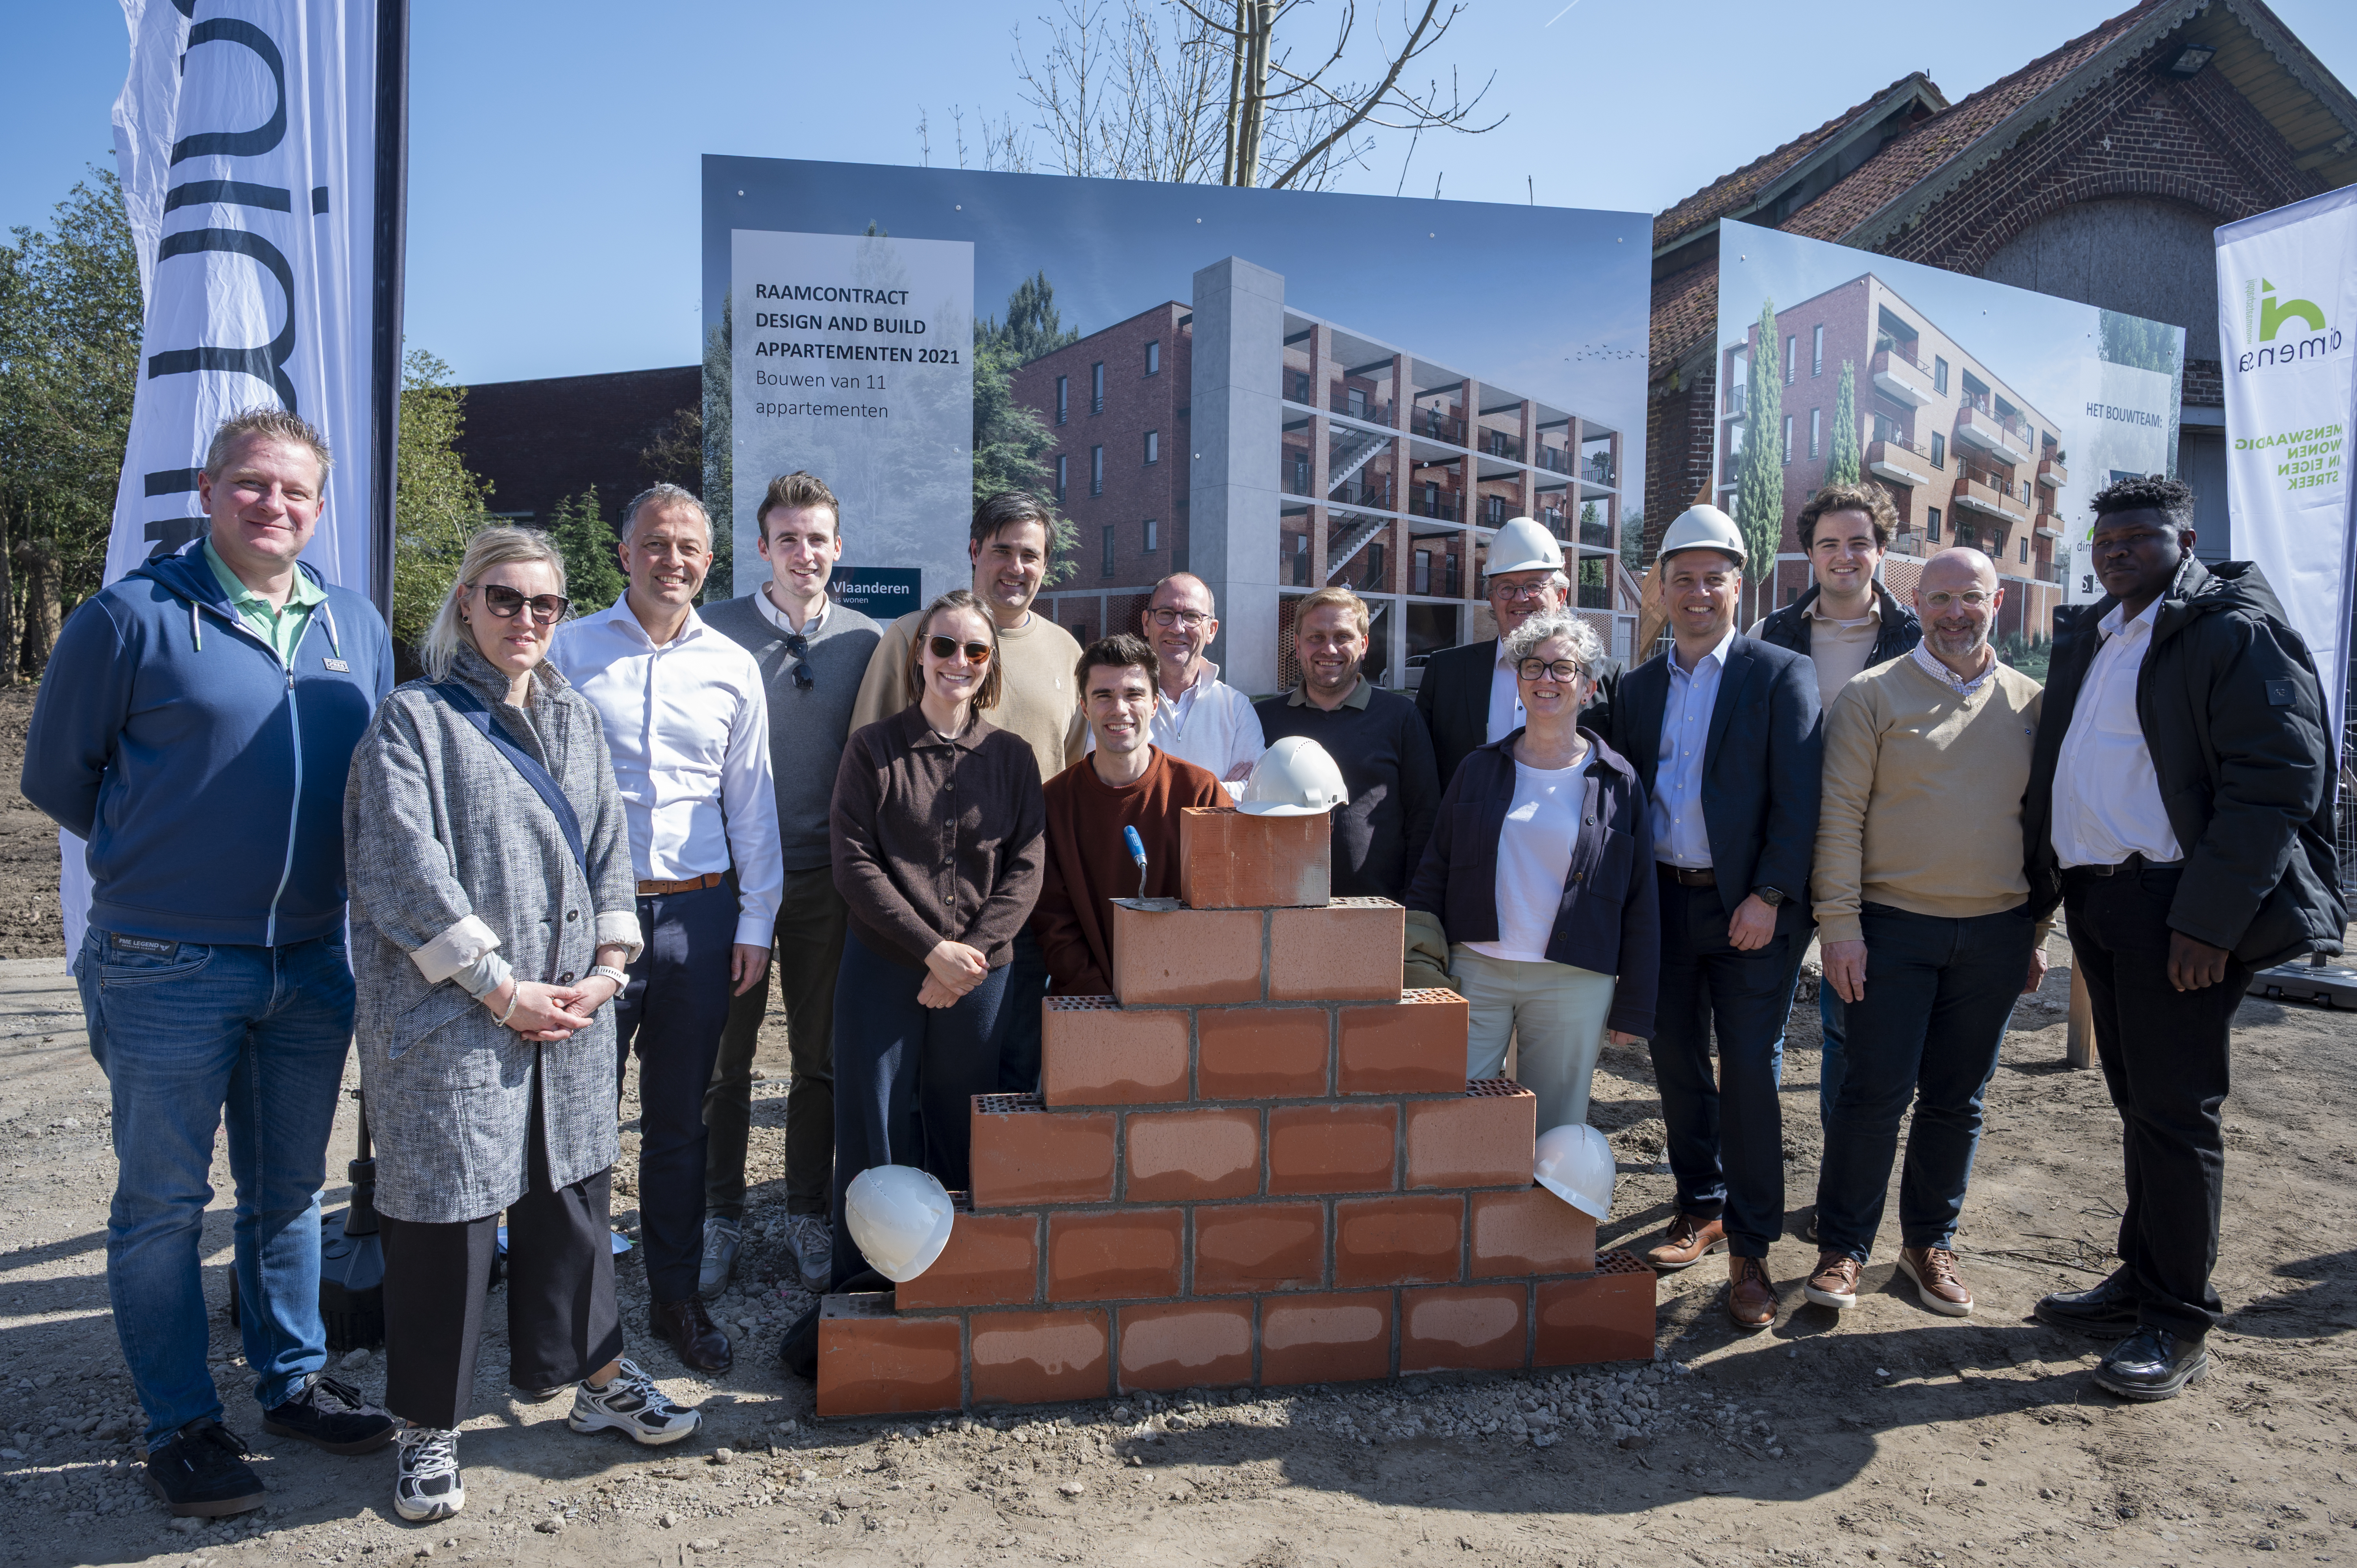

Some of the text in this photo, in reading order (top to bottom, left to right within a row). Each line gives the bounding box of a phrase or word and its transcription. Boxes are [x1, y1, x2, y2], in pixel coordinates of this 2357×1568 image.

[756, 284, 909, 305] RAAMCONTRACT
[756, 313, 926, 334] DESIGN AND BUILD
[755, 342, 960, 364] APPARTEMENTEN 2021
[756, 370, 886, 390] Bouwen van 11
[756, 401, 888, 418] appartementen
[2086, 402, 2162, 429] HET BOUWTEAM:
[833, 581, 909, 594] Vlaanderen
